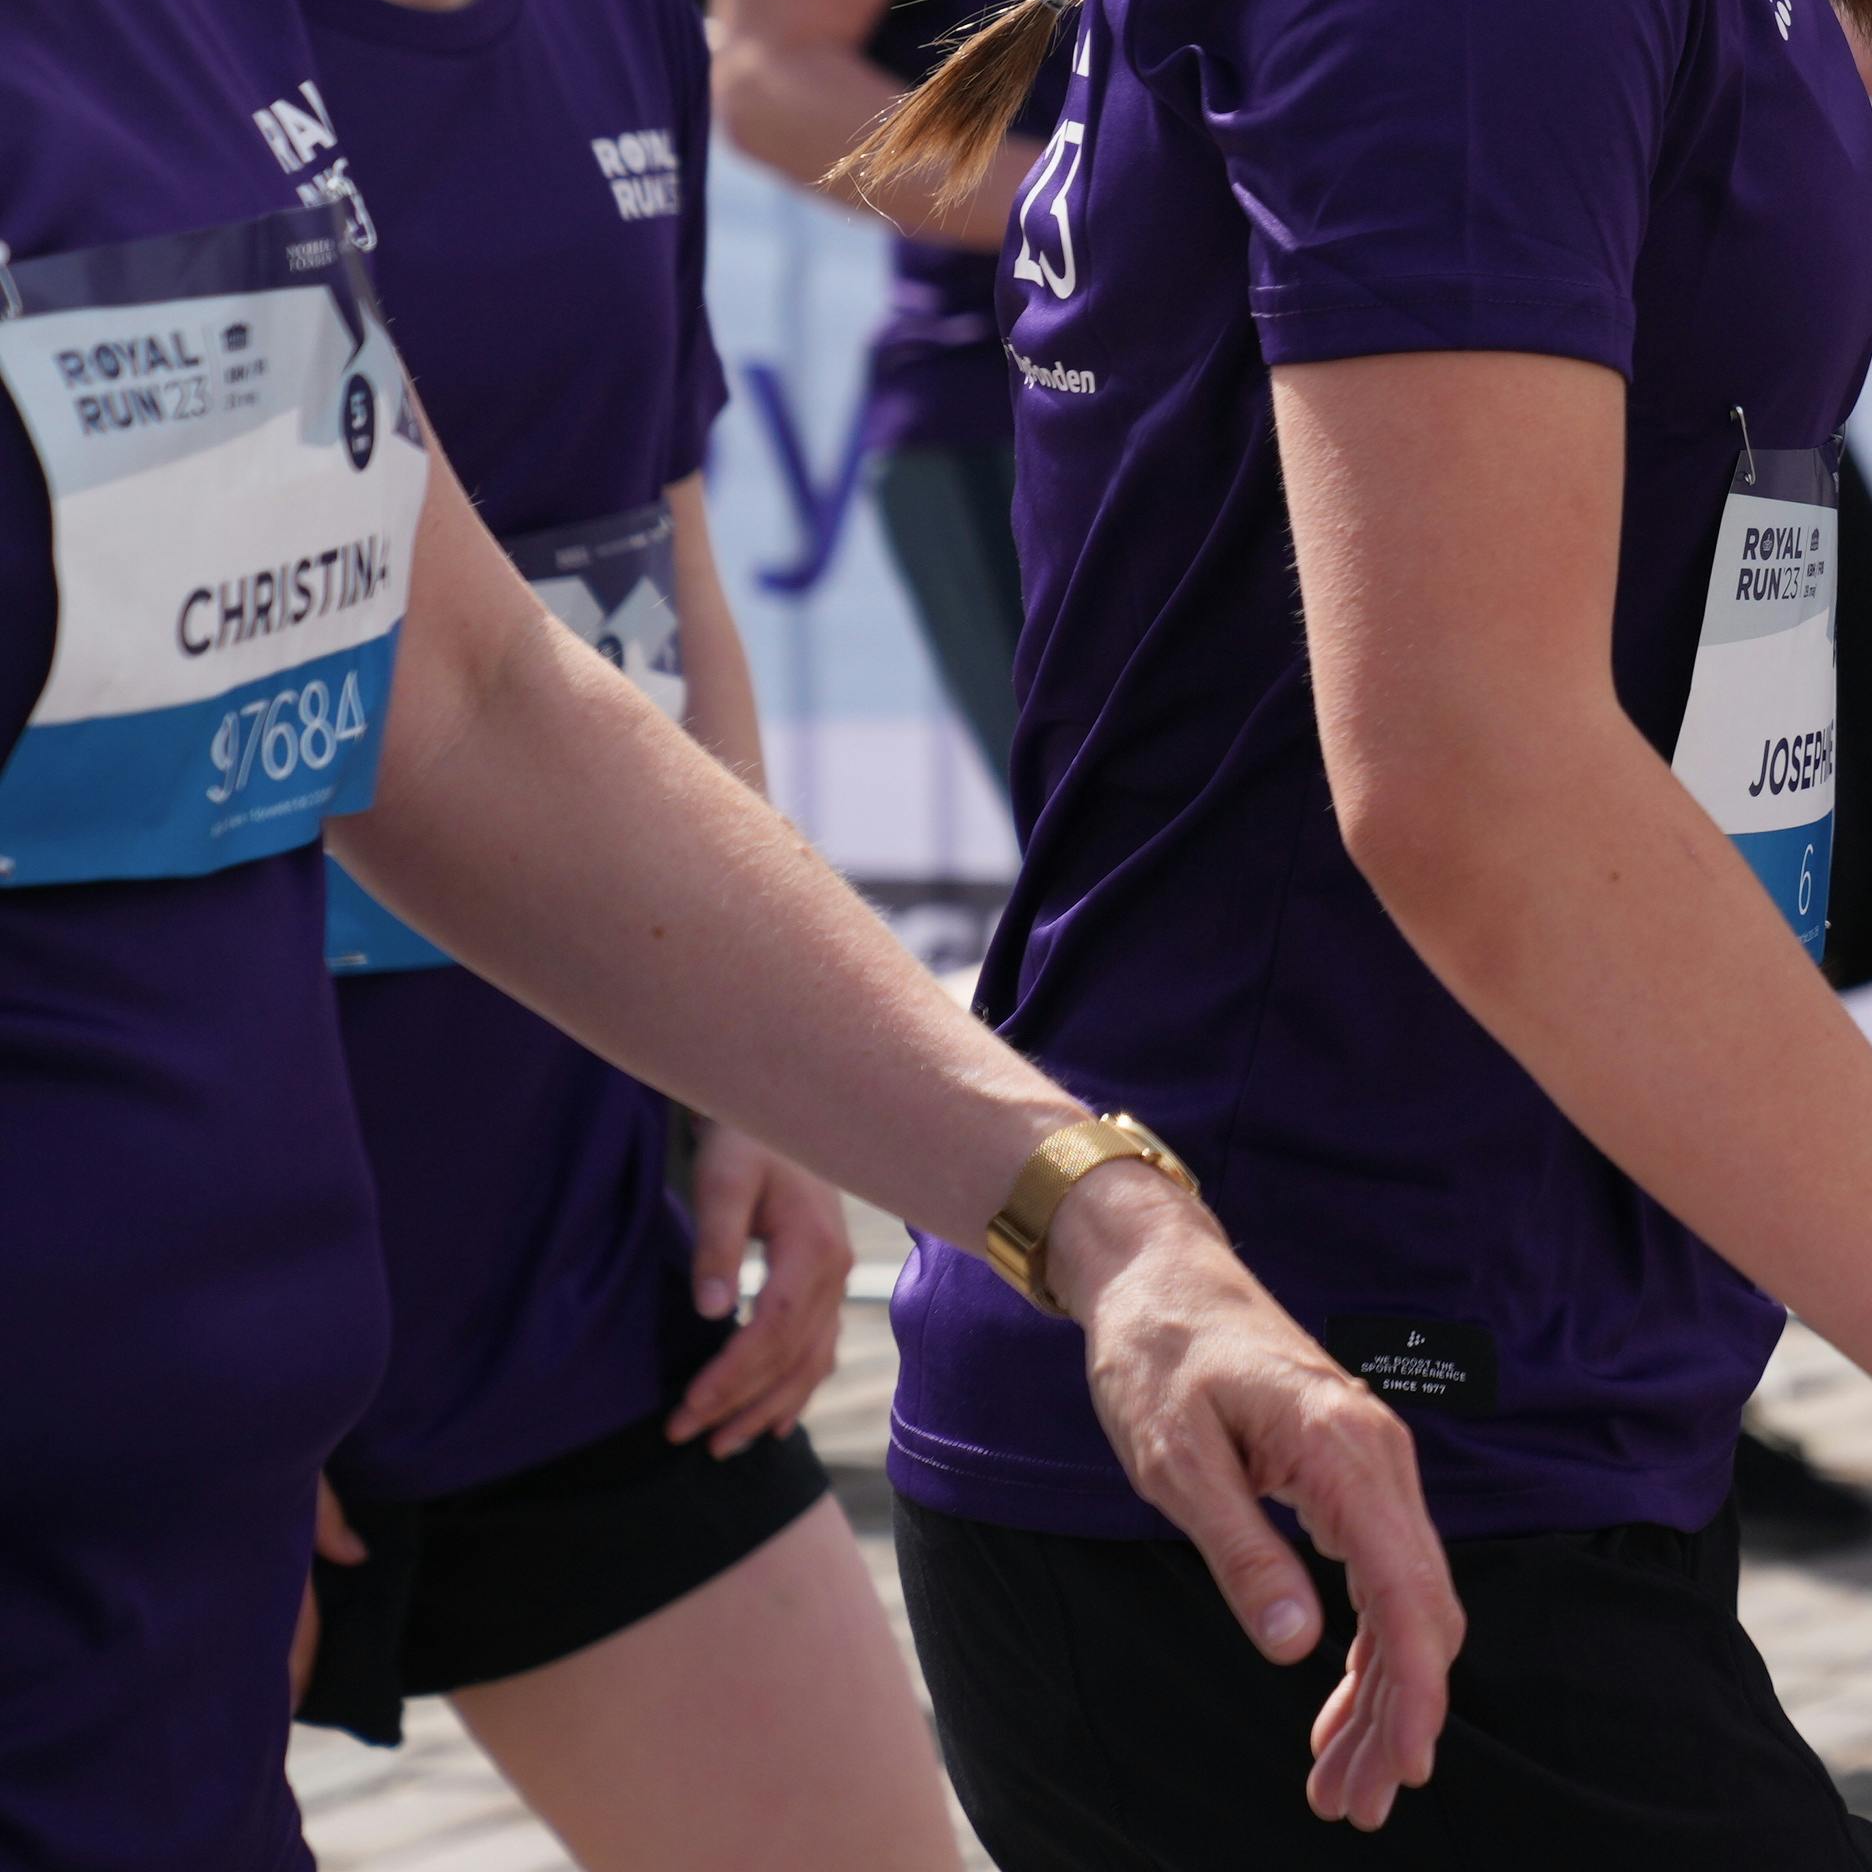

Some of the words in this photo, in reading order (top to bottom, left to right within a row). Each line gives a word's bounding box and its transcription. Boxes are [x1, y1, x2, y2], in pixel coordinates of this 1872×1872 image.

[54, 332, 201, 388] ROYAL
[1742, 527, 1802, 560] ROYAL
[206, 670, 368, 804] 97684
[1360, 1361, 1398, 1374] SPORT
[1400, 1365, 1467, 1383] EXPERIENCE
[1374, 1354, 1391, 1365] WE
[1394, 1355, 1432, 1369] BOOST
[1435, 1359, 1456, 1372] THE
[1382, 1379, 1418, 1392] SINCE
[1421, 1382, 1447, 1395] 1977
